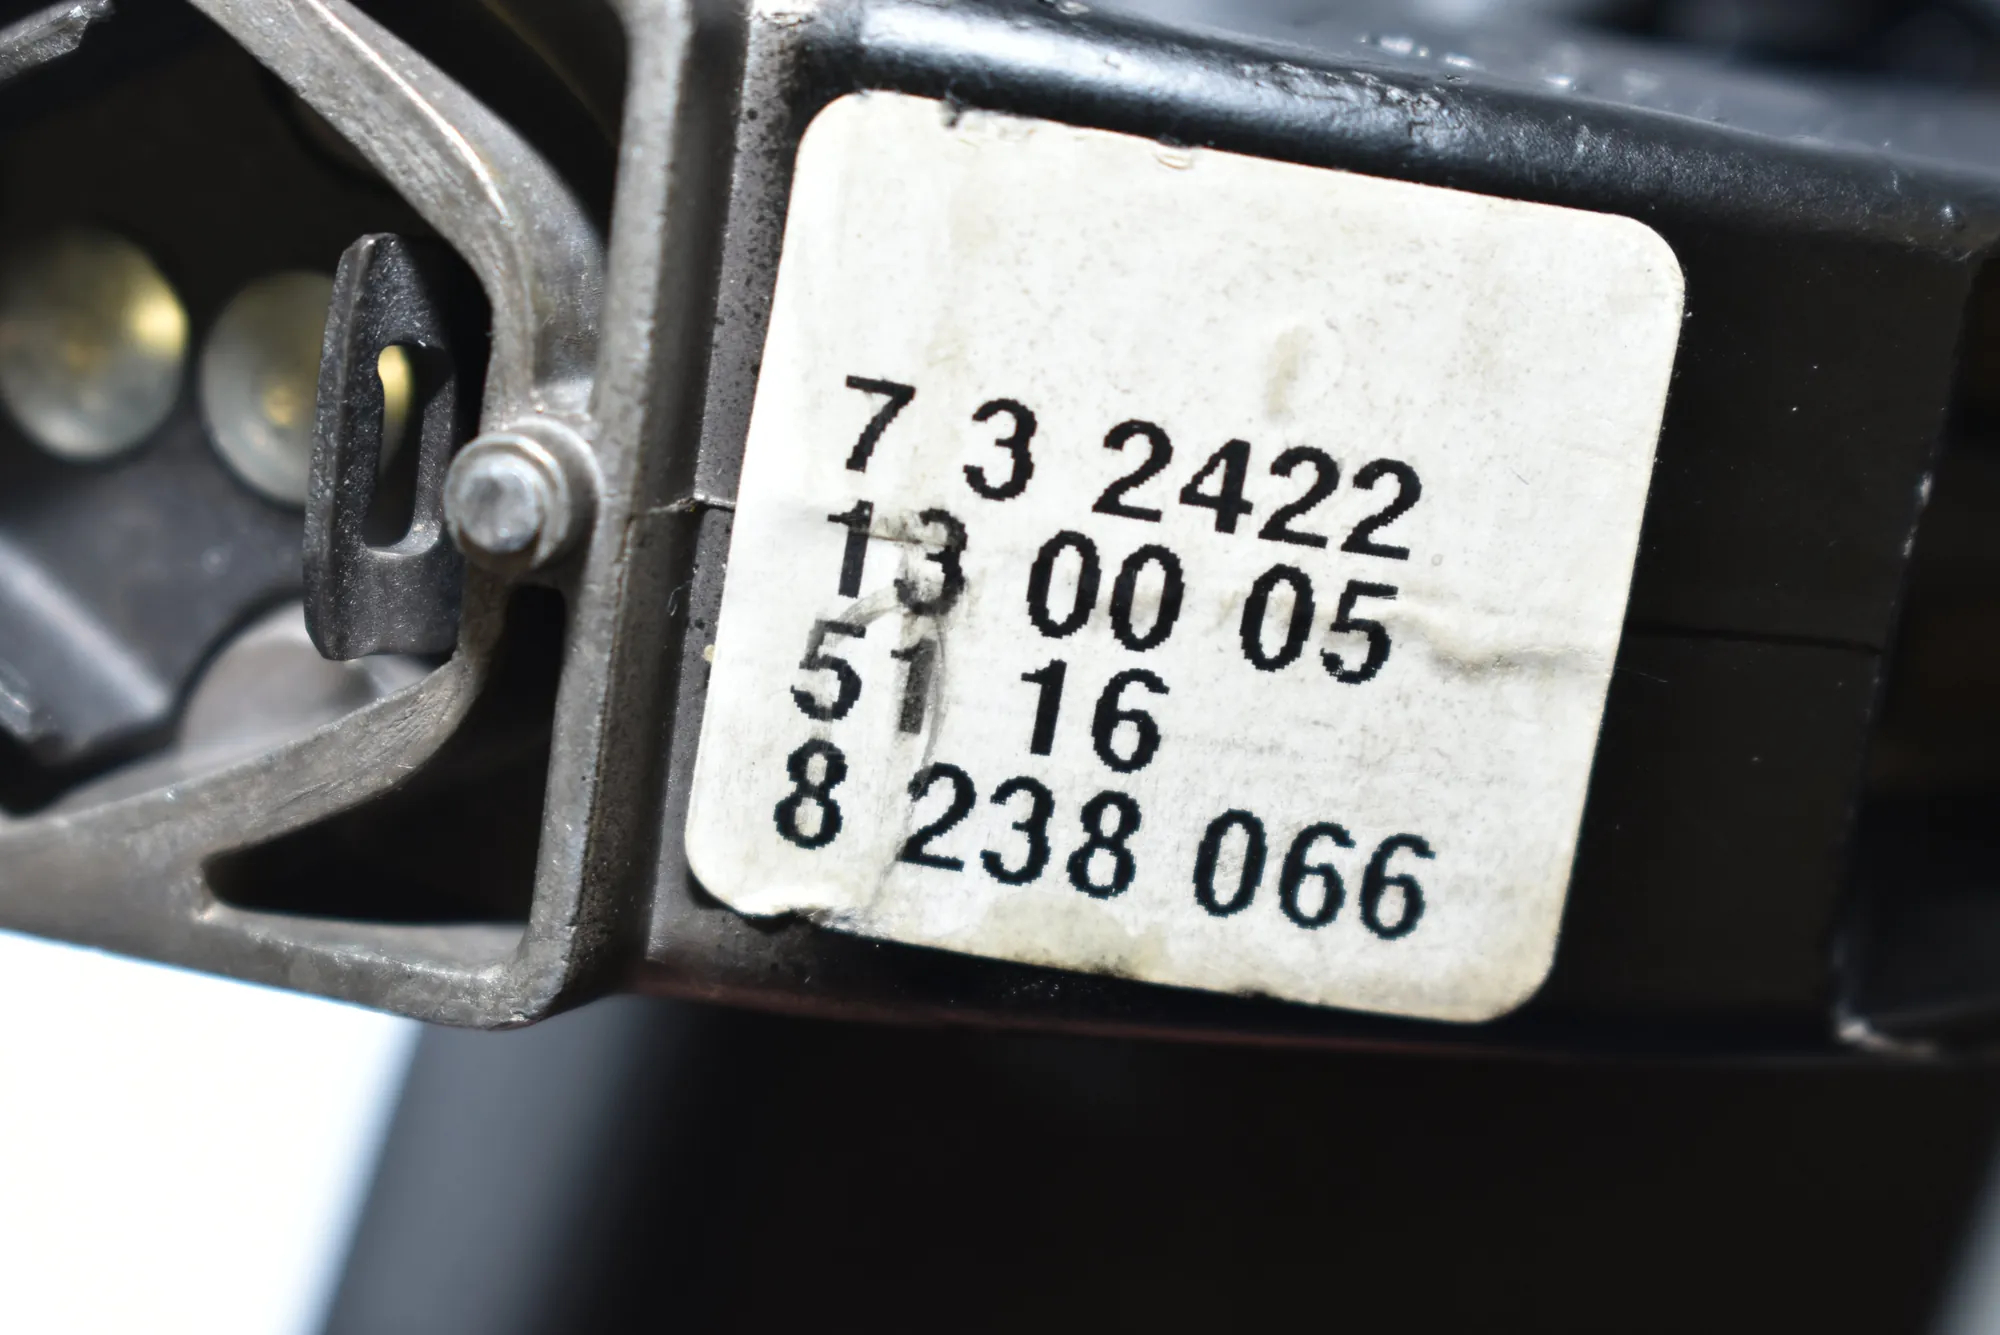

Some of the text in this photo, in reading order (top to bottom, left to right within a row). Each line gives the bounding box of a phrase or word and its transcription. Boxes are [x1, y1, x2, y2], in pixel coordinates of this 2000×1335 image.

[845, 375, 1423, 561] 7 3 2422
[827, 499, 1400, 685] 13 00 05
[790, 619, 1170, 775] 51 16
[773, 737, 1436, 941] 8 238 066
